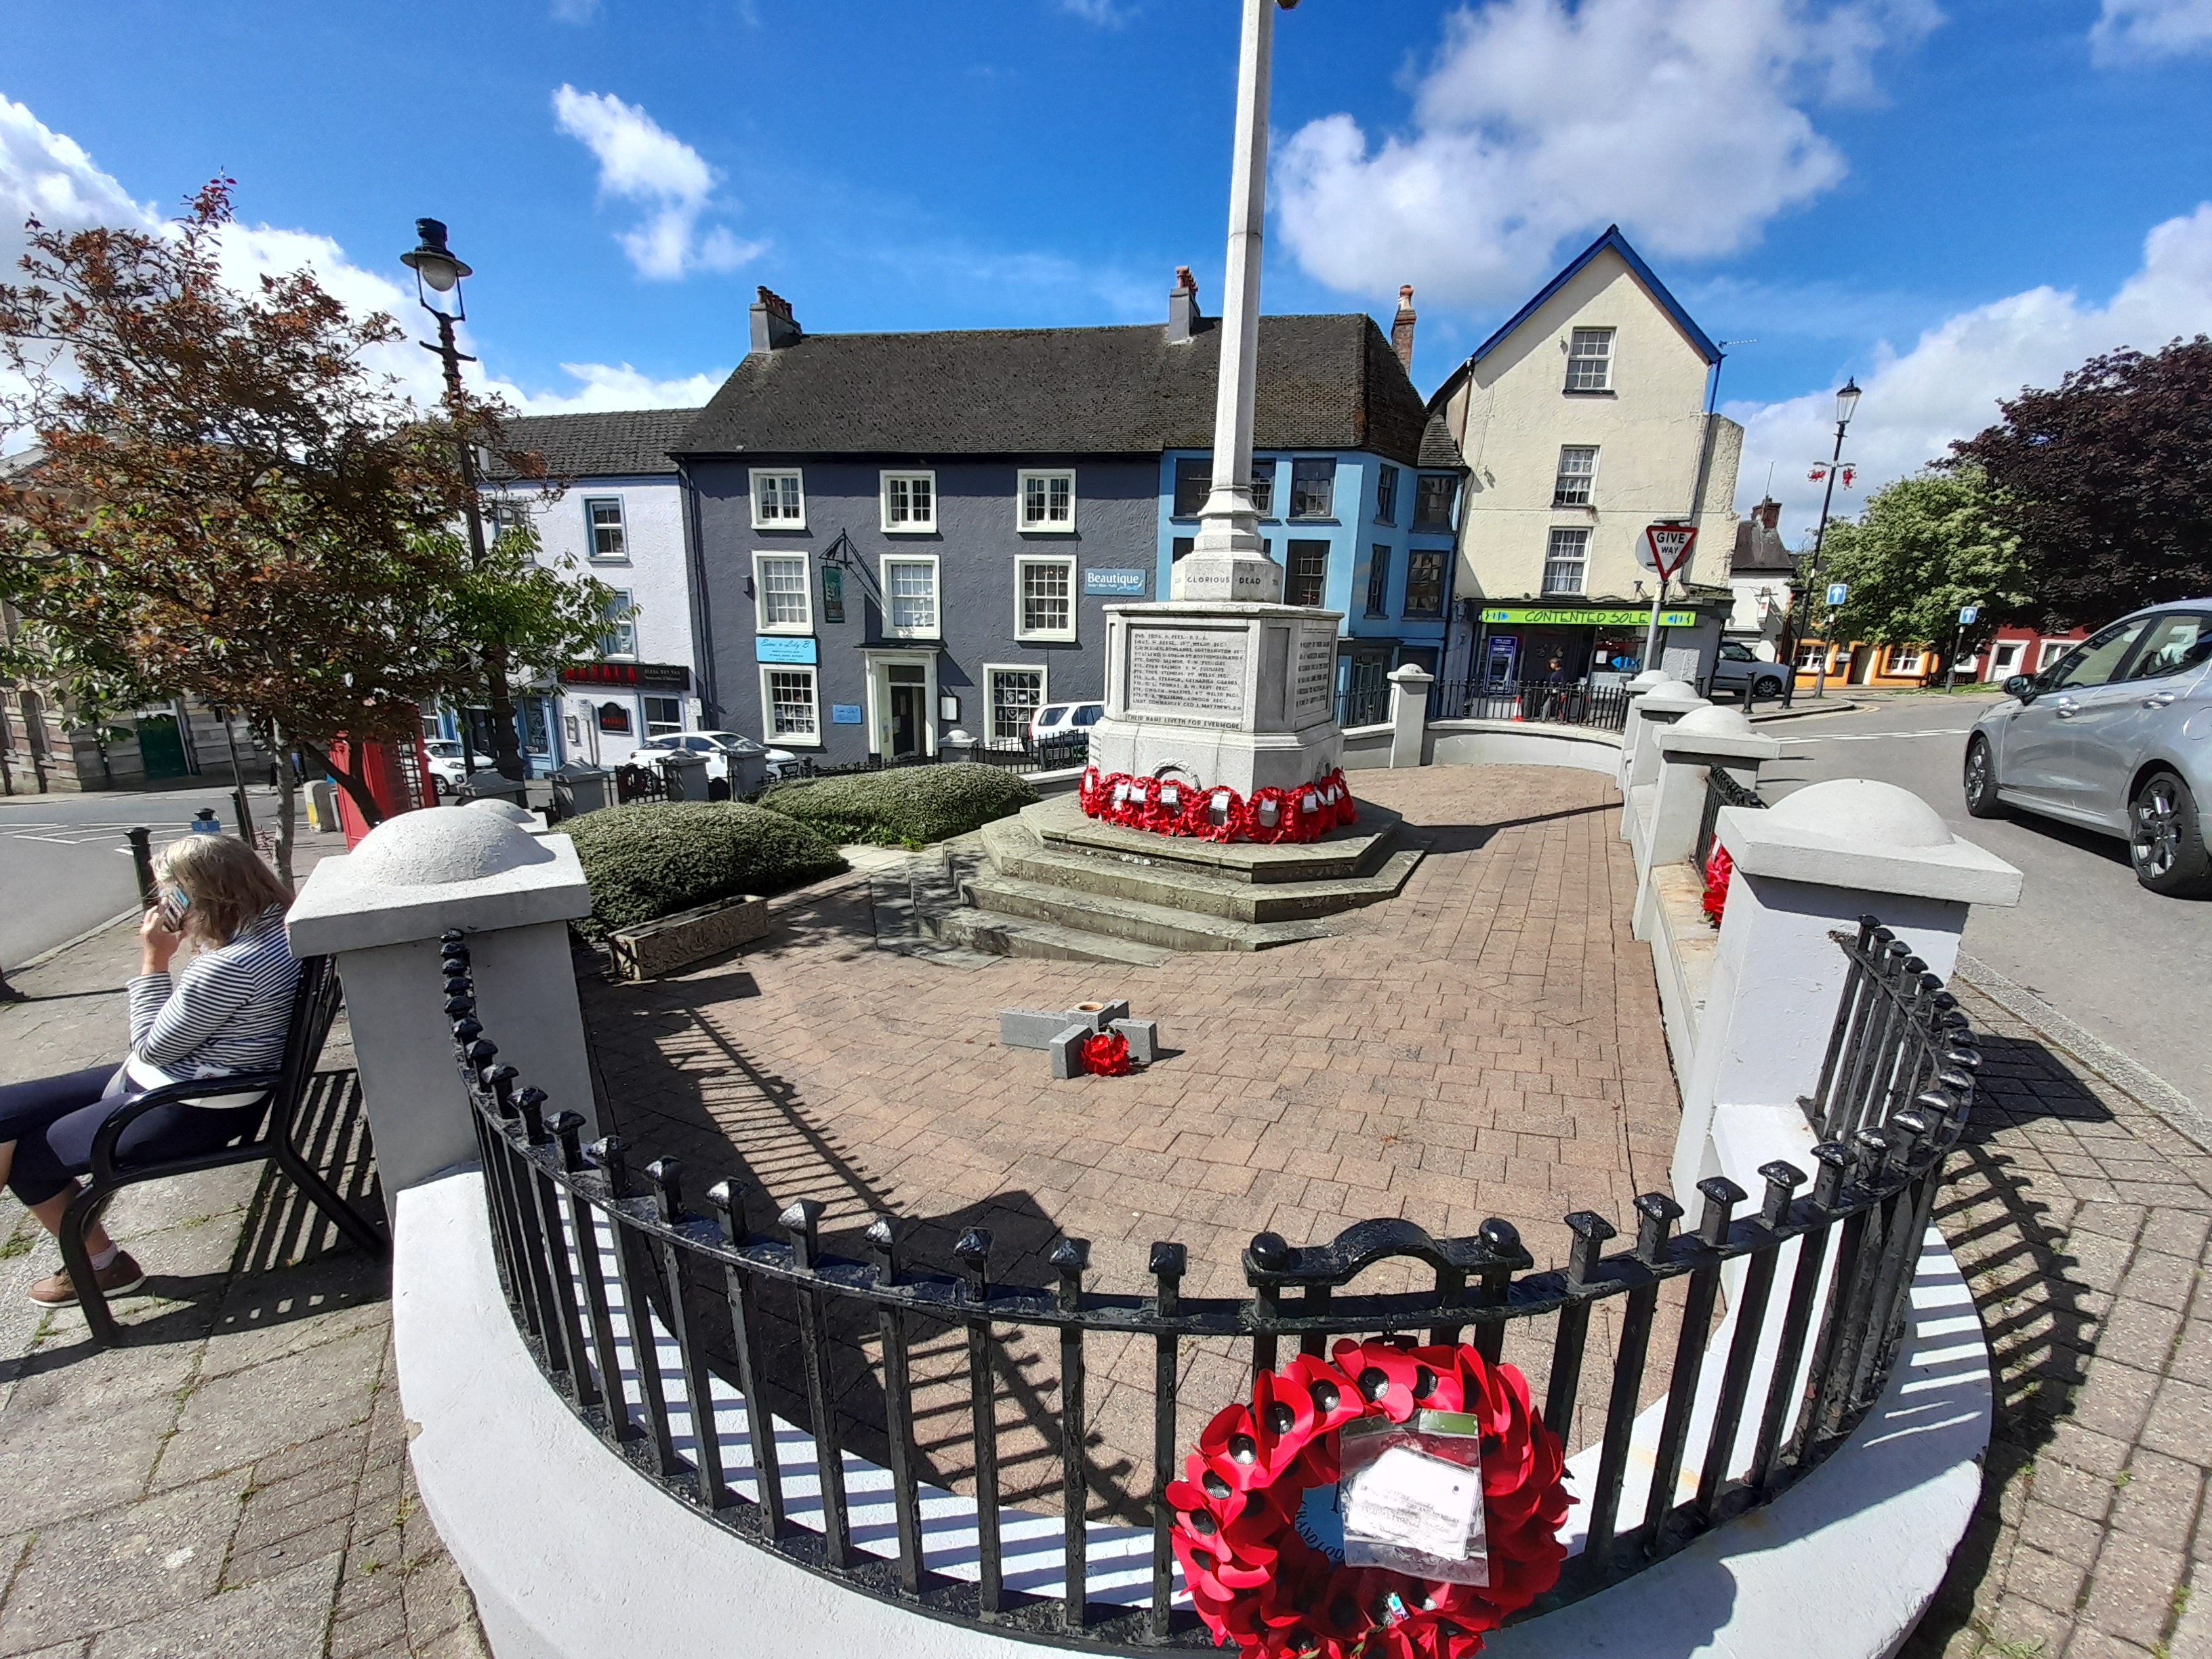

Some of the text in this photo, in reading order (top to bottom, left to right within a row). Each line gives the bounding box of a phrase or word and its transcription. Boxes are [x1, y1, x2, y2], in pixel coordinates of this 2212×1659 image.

[1656, 532, 1685, 544] GIVE
[1661, 546, 1679, 554] WAY
[1088, 572, 1139, 588] Beautique
[1525, 610, 1649, 624] CONTENTED SOLE
[1204, 720, 1240, 730] EVERMORE
